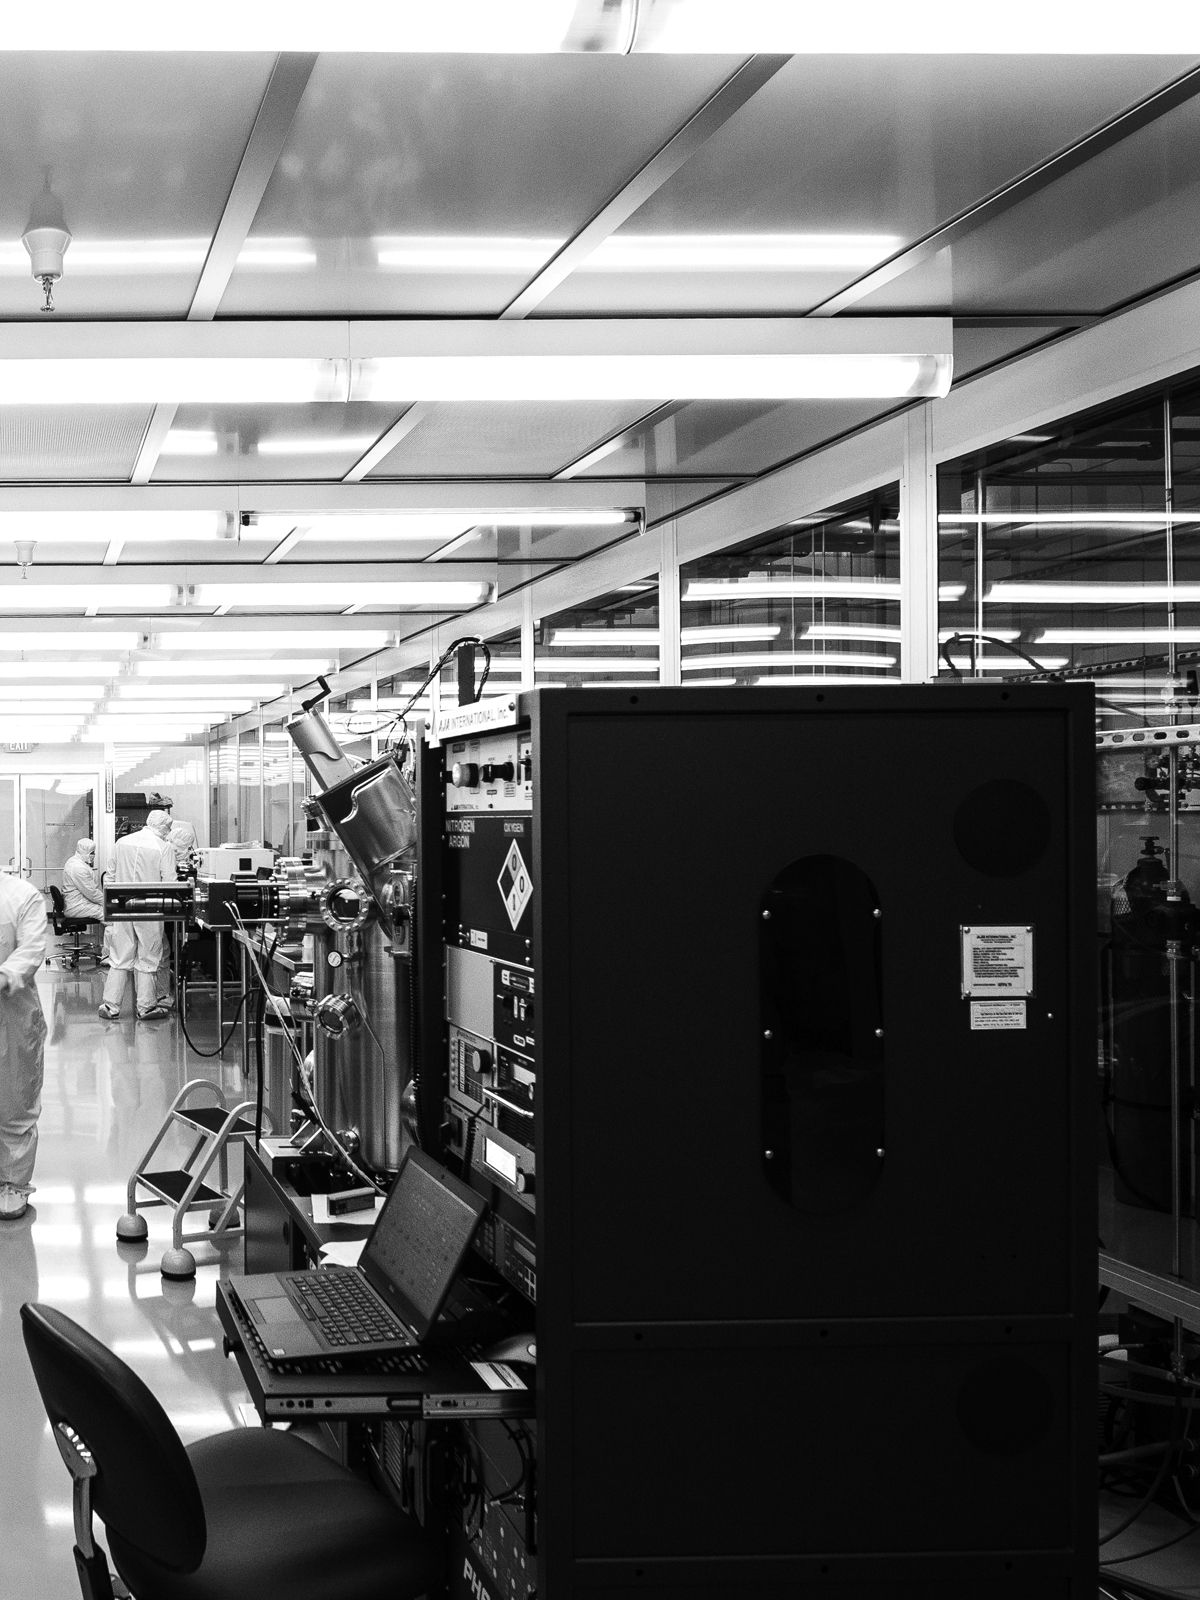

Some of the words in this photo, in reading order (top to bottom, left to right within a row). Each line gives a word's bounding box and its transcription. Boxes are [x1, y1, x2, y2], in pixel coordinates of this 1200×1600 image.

[445, 819, 475, 833] NITROGEN
[503, 822, 524, 833] OXYGEN
[448, 835, 470, 849] ARGON
[511, 854, 517, 871] 0
[519, 875, 525, 893] 0
[512, 893, 516, 911] 1
